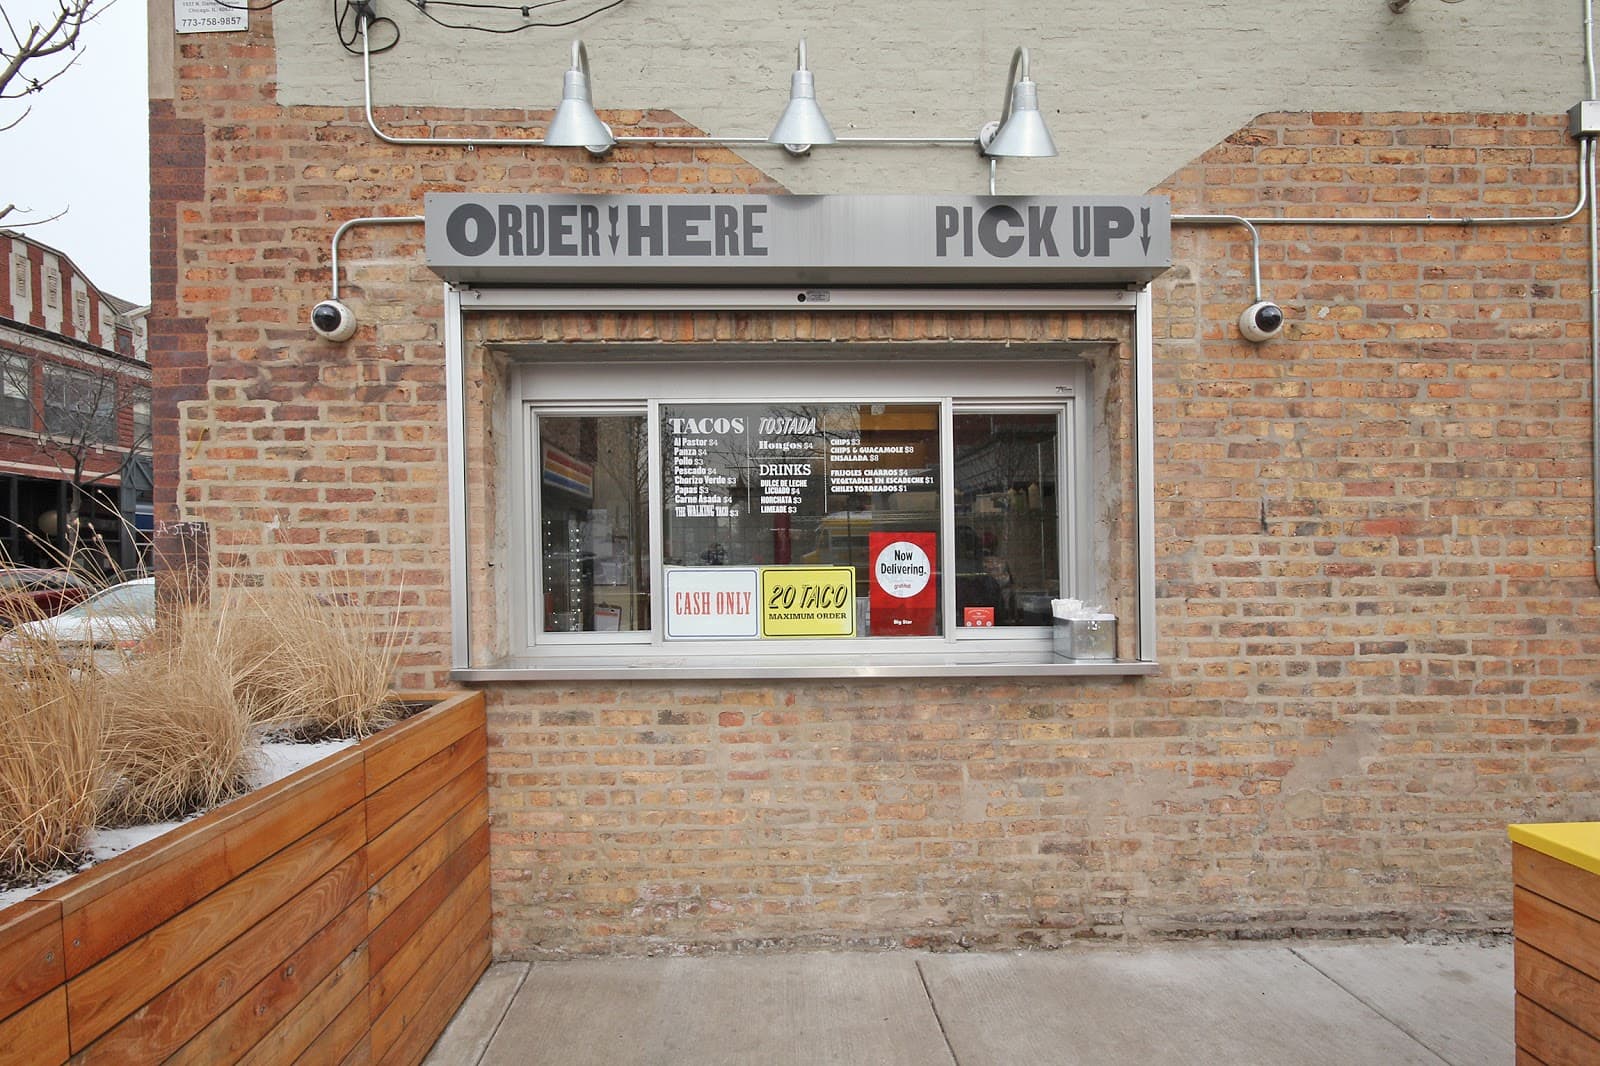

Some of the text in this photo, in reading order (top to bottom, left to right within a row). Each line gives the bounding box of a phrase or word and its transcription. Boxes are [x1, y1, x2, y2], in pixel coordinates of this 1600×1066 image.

[181, 17, 241, 27] 773-758-9857
[446, 203, 769, 257] ORDER HERE
[936, 204, 1135, 258] PICK UP
[669, 418, 744, 434] TACOS
[758, 416, 816, 434] TOSTADA
[674, 438, 718, 447] Al Pastor $4
[758, 440, 813, 451] Hongos $4
[674, 447, 697, 456] Panza
[674, 457, 693, 465] Pollo
[674, 467, 706, 475] Pescado
[760, 464, 811, 476] DRINKS
[674, 476, 736, 485] Chorizo Verde $3
[675, 486, 709, 495] Papas $3
[675, 495, 697, 503] Carne
[698, 495, 722, 503] Asada
[760, 496, 792, 504] HORCHATA
[675, 506, 686, 517] THE
[687, 505, 715, 517] WALKING
[730, 509, 738, 517] $3
[788, 506, 797, 514] $3
[894, 550, 913, 561] Now
[881, 564, 927, 576] Delivering.
[768, 584, 848, 609] 20 TACO
[675, 592, 751, 615] CASH ONLY
[816, 612, 847, 620] ORDER
